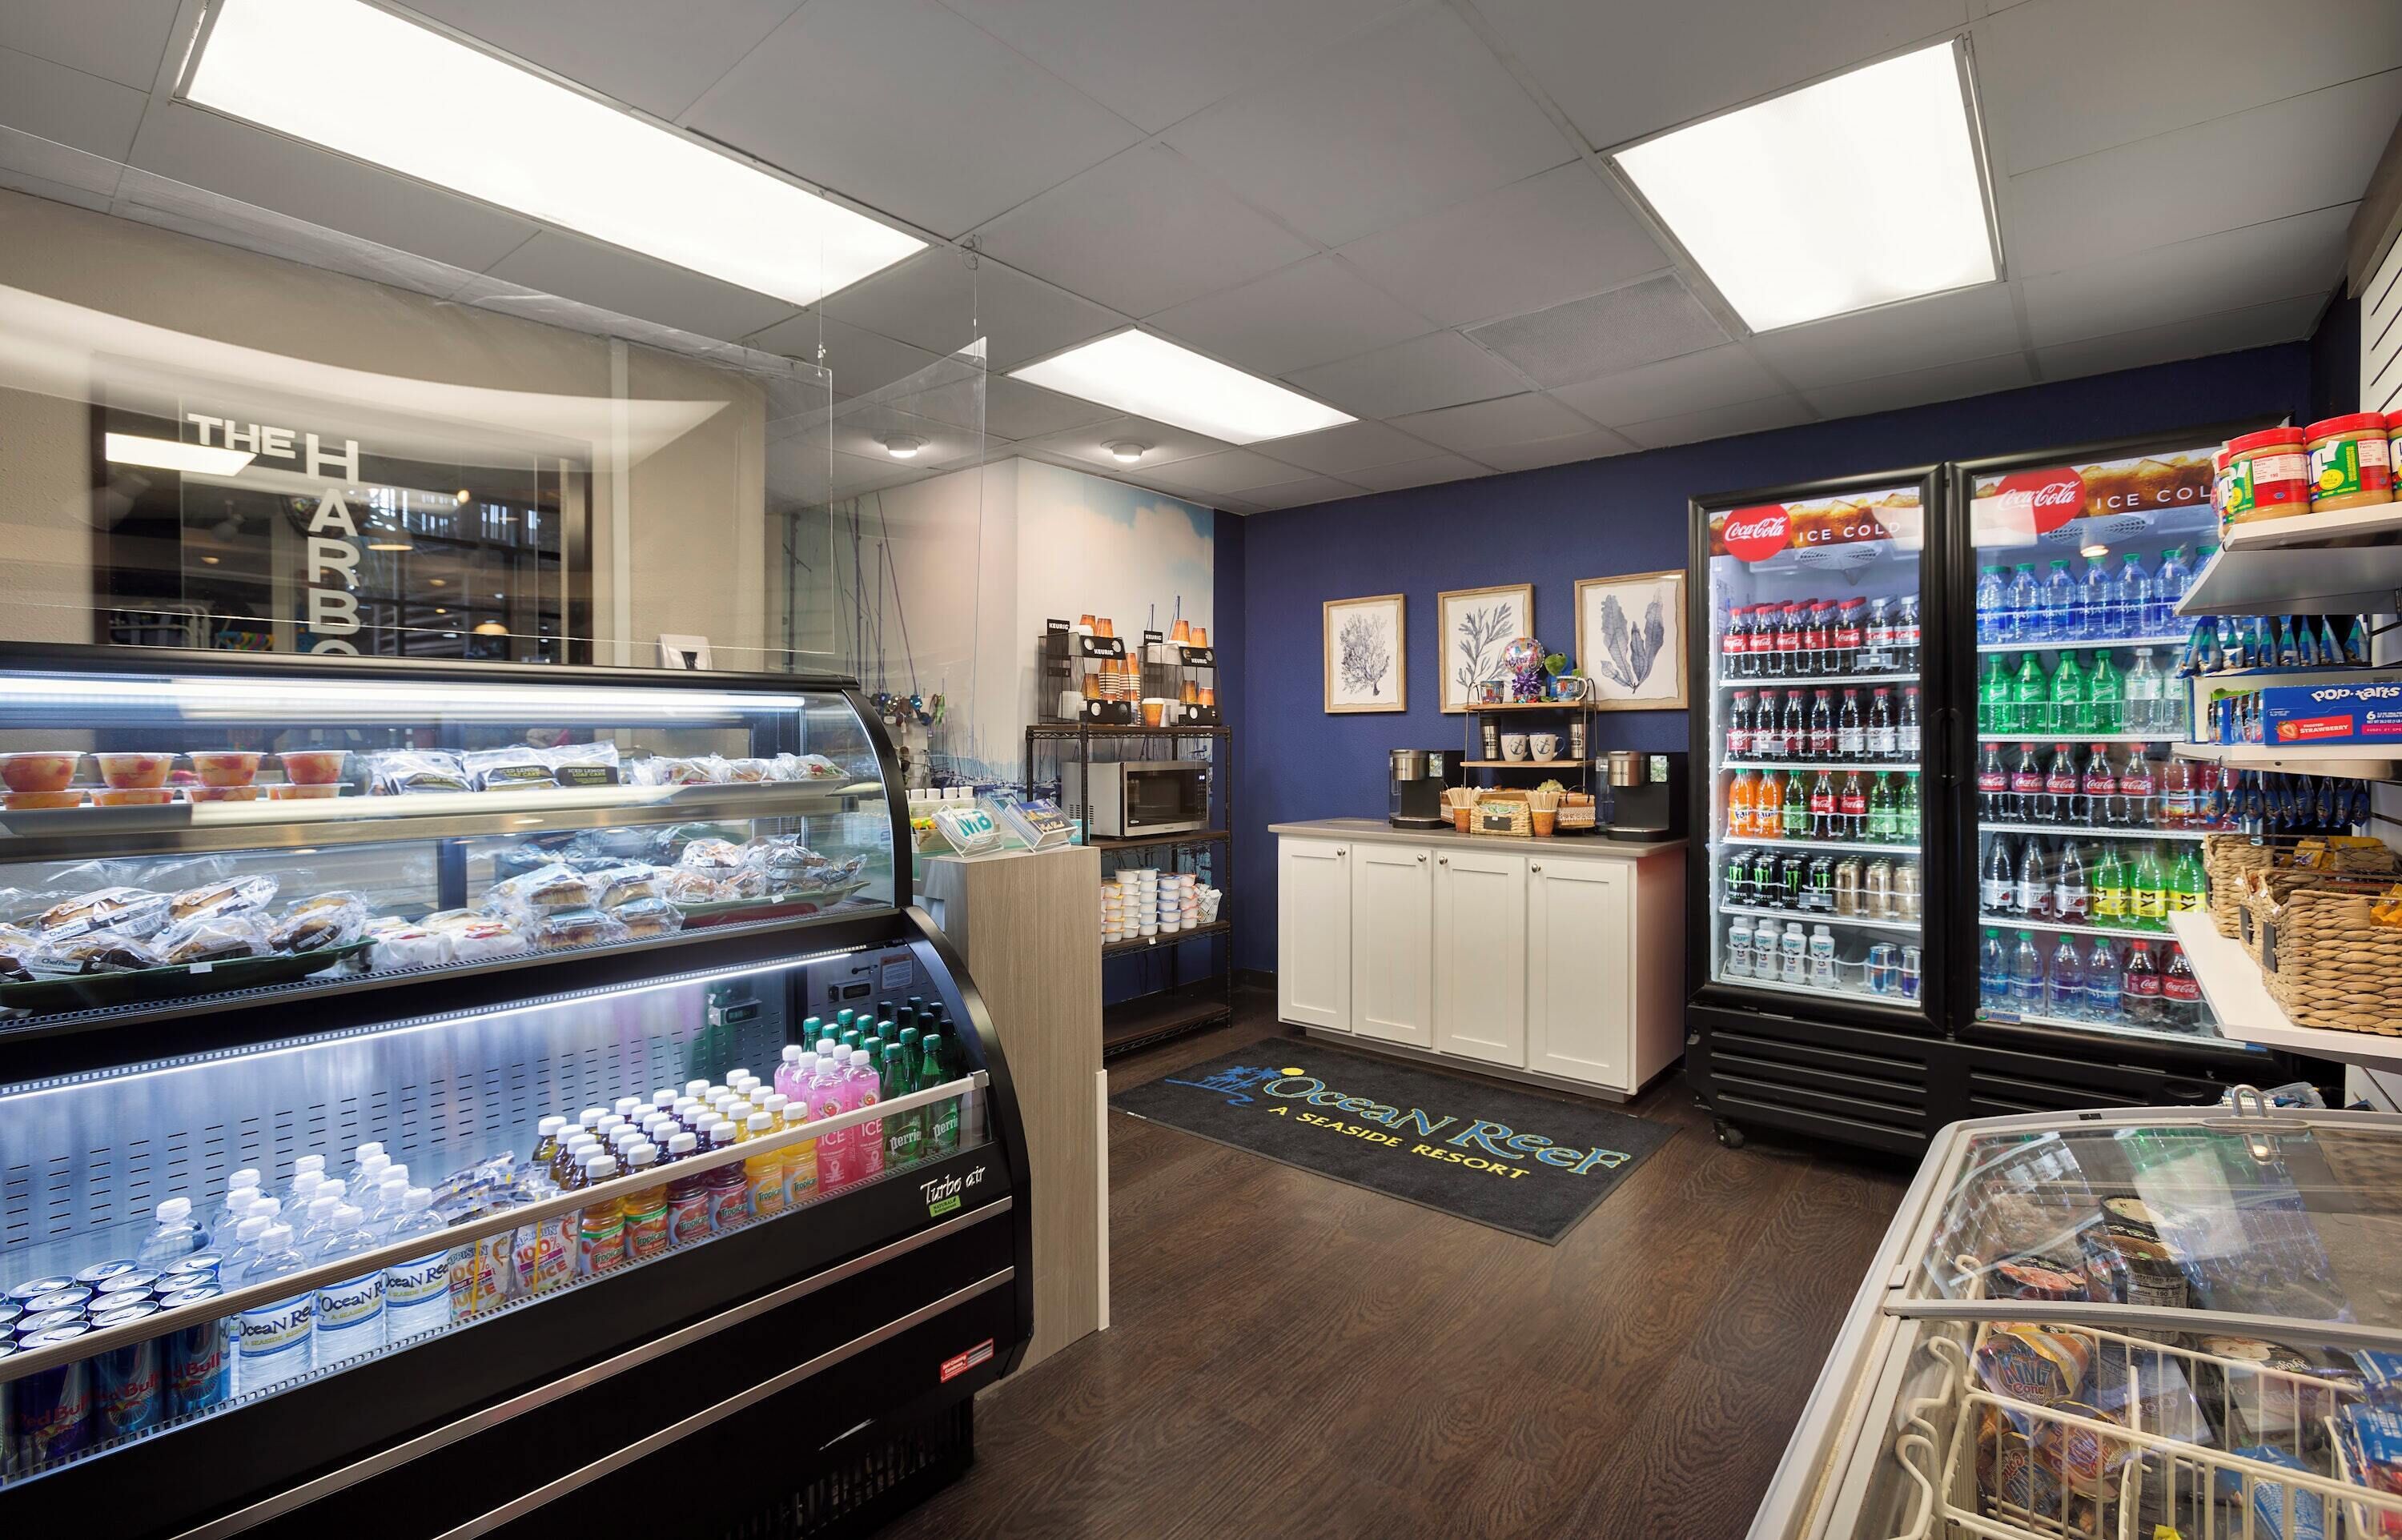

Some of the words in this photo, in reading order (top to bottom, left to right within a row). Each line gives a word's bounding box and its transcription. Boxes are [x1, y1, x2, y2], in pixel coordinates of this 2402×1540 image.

[187, 413, 296, 459] THE
[1998, 480, 2080, 511] Coca-Cola
[2097, 494, 2139, 510] ICE
[2157, 485, 2211, 503] COL
[1725, 516, 1788, 541] Coca-Cola
[1799, 528, 1832, 543] ICE
[1843, 522, 1901, 539] COLD
[2366, 711, 2376, 720] 6
[2300, 725, 2349, 735] STRAWBERRY
[821, 1130, 846, 1146] ICE
[862, 1118, 883, 1137] ICE
[890, 1129, 922, 1157] perrie
[1267, 1105, 1287, 1117] A
[1295, 1112, 1400, 1148] SEASIDE
[1411, 1143, 1530, 1181] RESORT
[920, 1173, 962, 1205] Turbo
[966, 1165, 986, 1189] air
[517, 1237, 560, 1264] 100%
[186, 1350, 221, 1376] Bull
[125, 1370, 159, 1397] Bull
[2011, 1382, 2045, 1395] Cone
